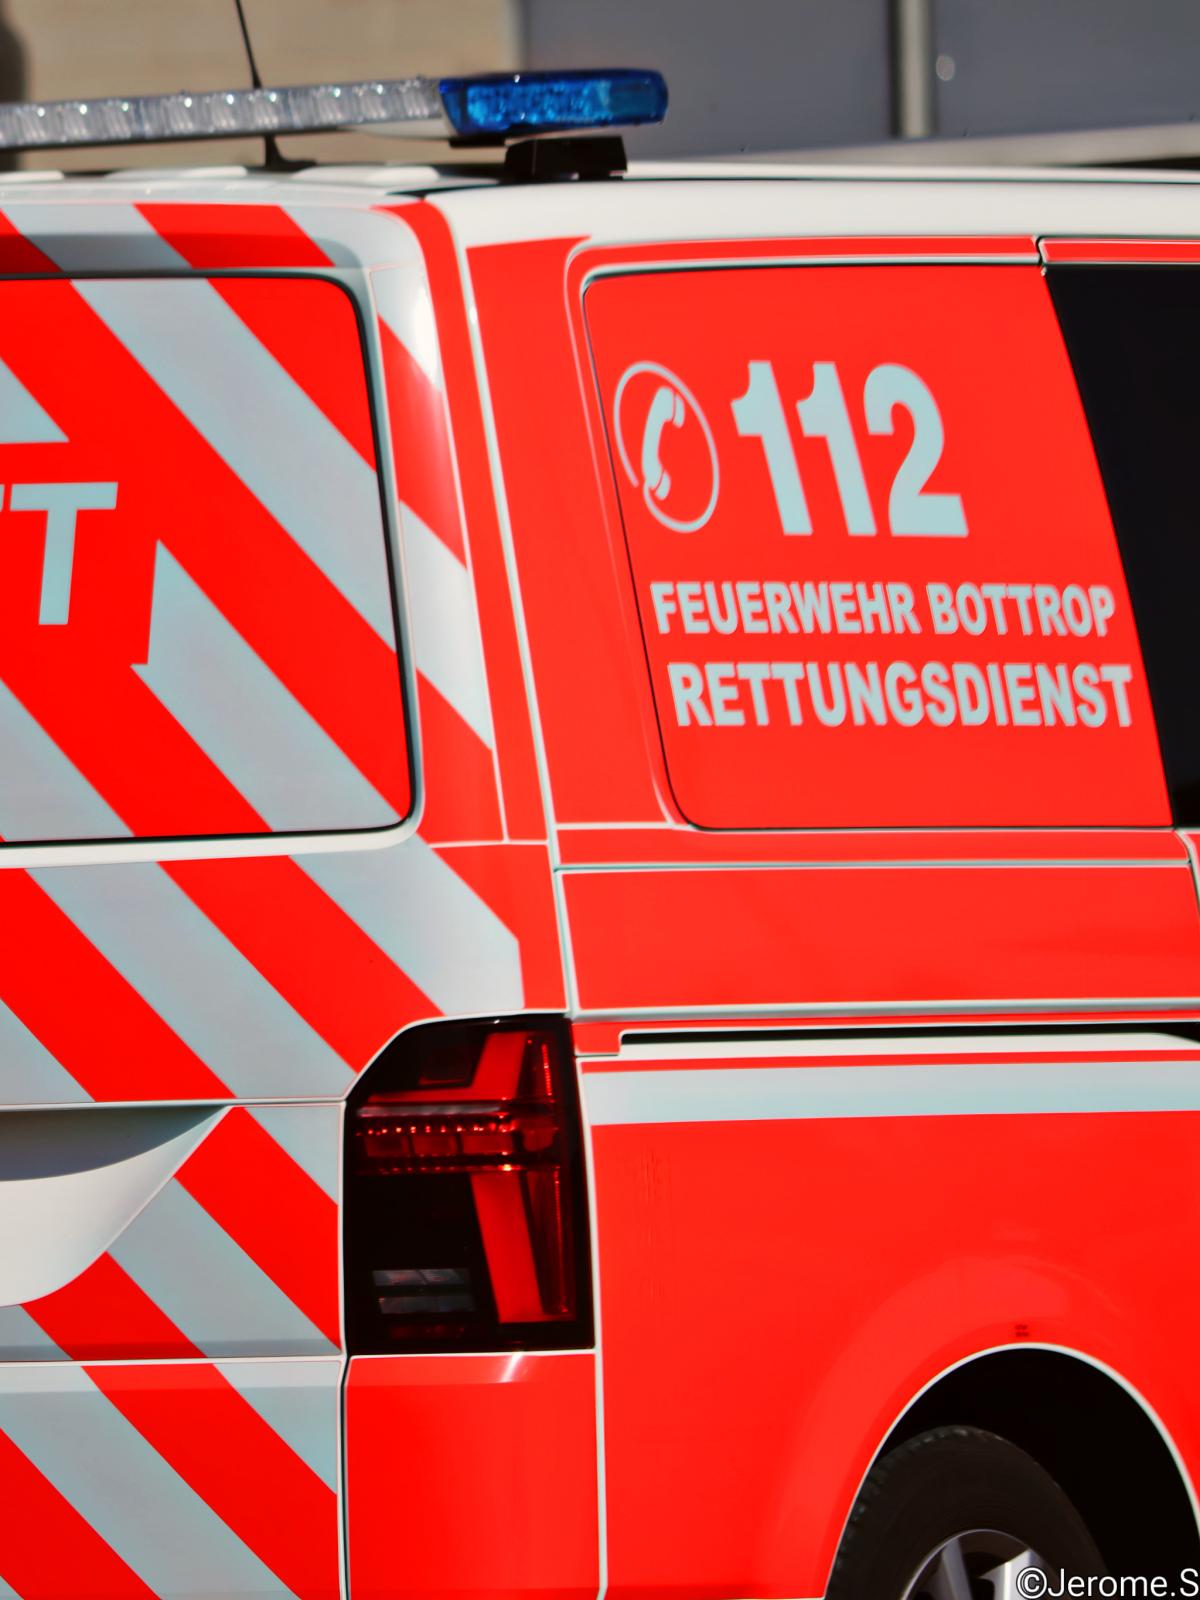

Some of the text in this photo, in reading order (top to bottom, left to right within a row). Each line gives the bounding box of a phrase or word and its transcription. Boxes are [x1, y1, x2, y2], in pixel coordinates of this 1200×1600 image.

[731, 361, 969, 538] 112
[650, 581, 1116, 637] FEUERWEHR BOTTROP
[667, 661, 1133, 728] RETTUNGSDIENST
